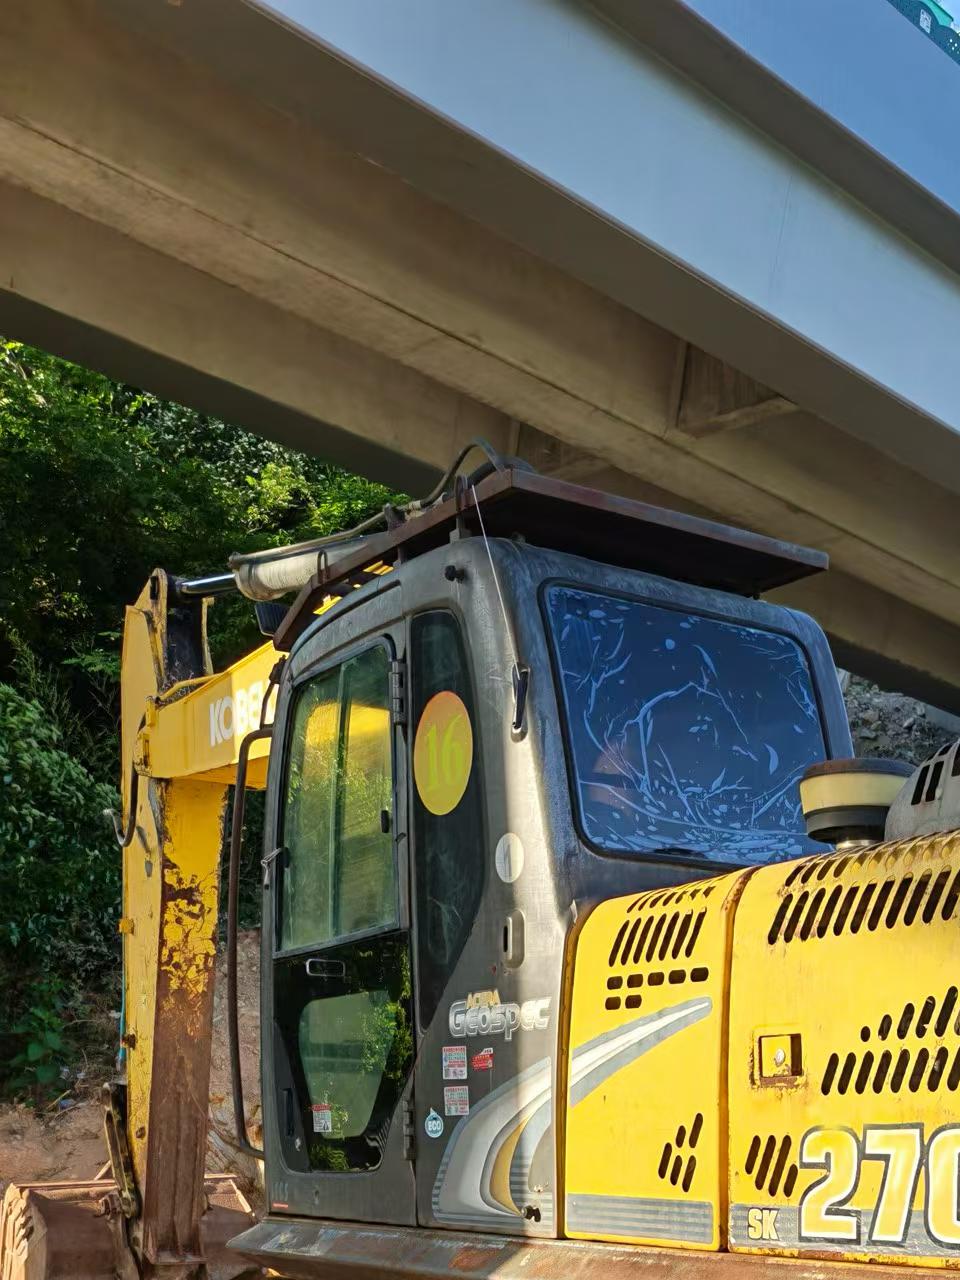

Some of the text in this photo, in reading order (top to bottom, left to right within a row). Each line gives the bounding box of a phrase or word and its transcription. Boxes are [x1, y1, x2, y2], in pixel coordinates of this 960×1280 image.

[424, 714, 465, 793] 16
[449, 996, 552, 1041] Geospec
[428, 1120, 442, 1131] ECO
[747, 1208, 779, 1241] SK
